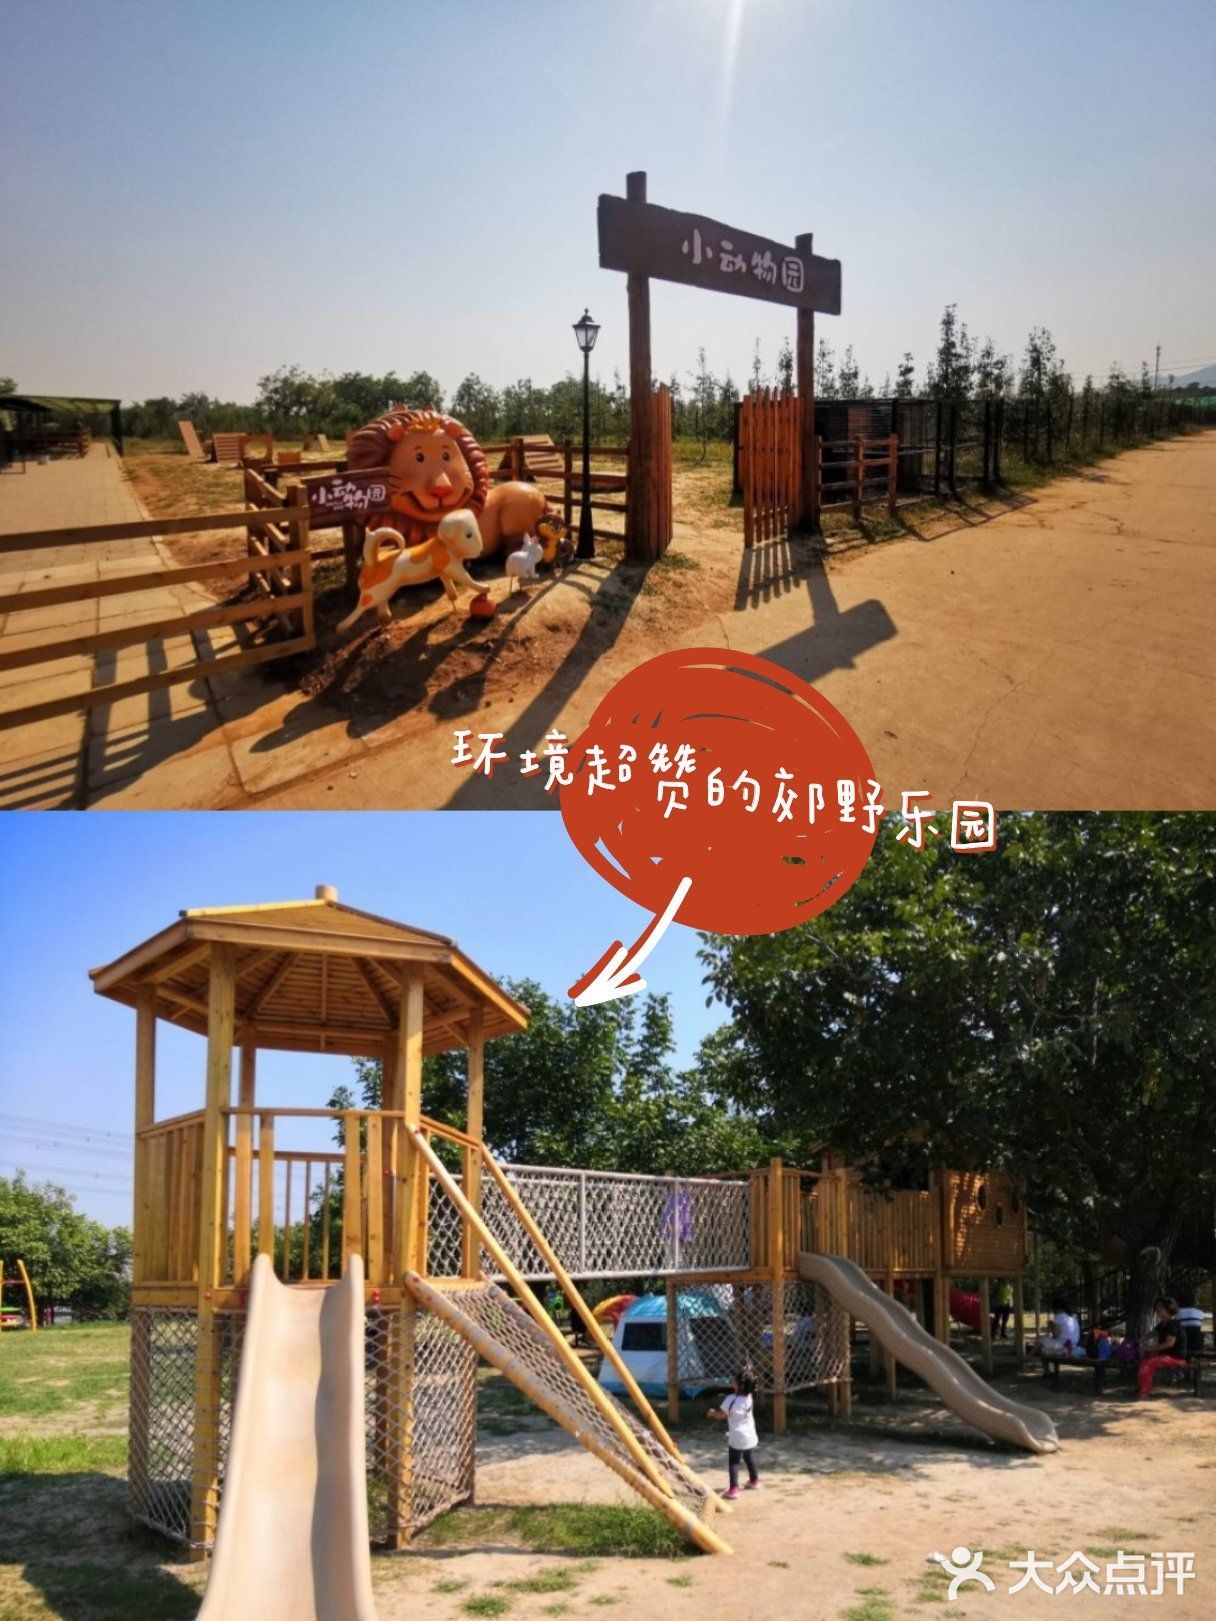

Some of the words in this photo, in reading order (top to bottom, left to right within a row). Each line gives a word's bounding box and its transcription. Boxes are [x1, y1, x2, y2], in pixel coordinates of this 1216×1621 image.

[682, 229, 804, 293] 小动物园
[311, 479, 386, 509] 小动物园
